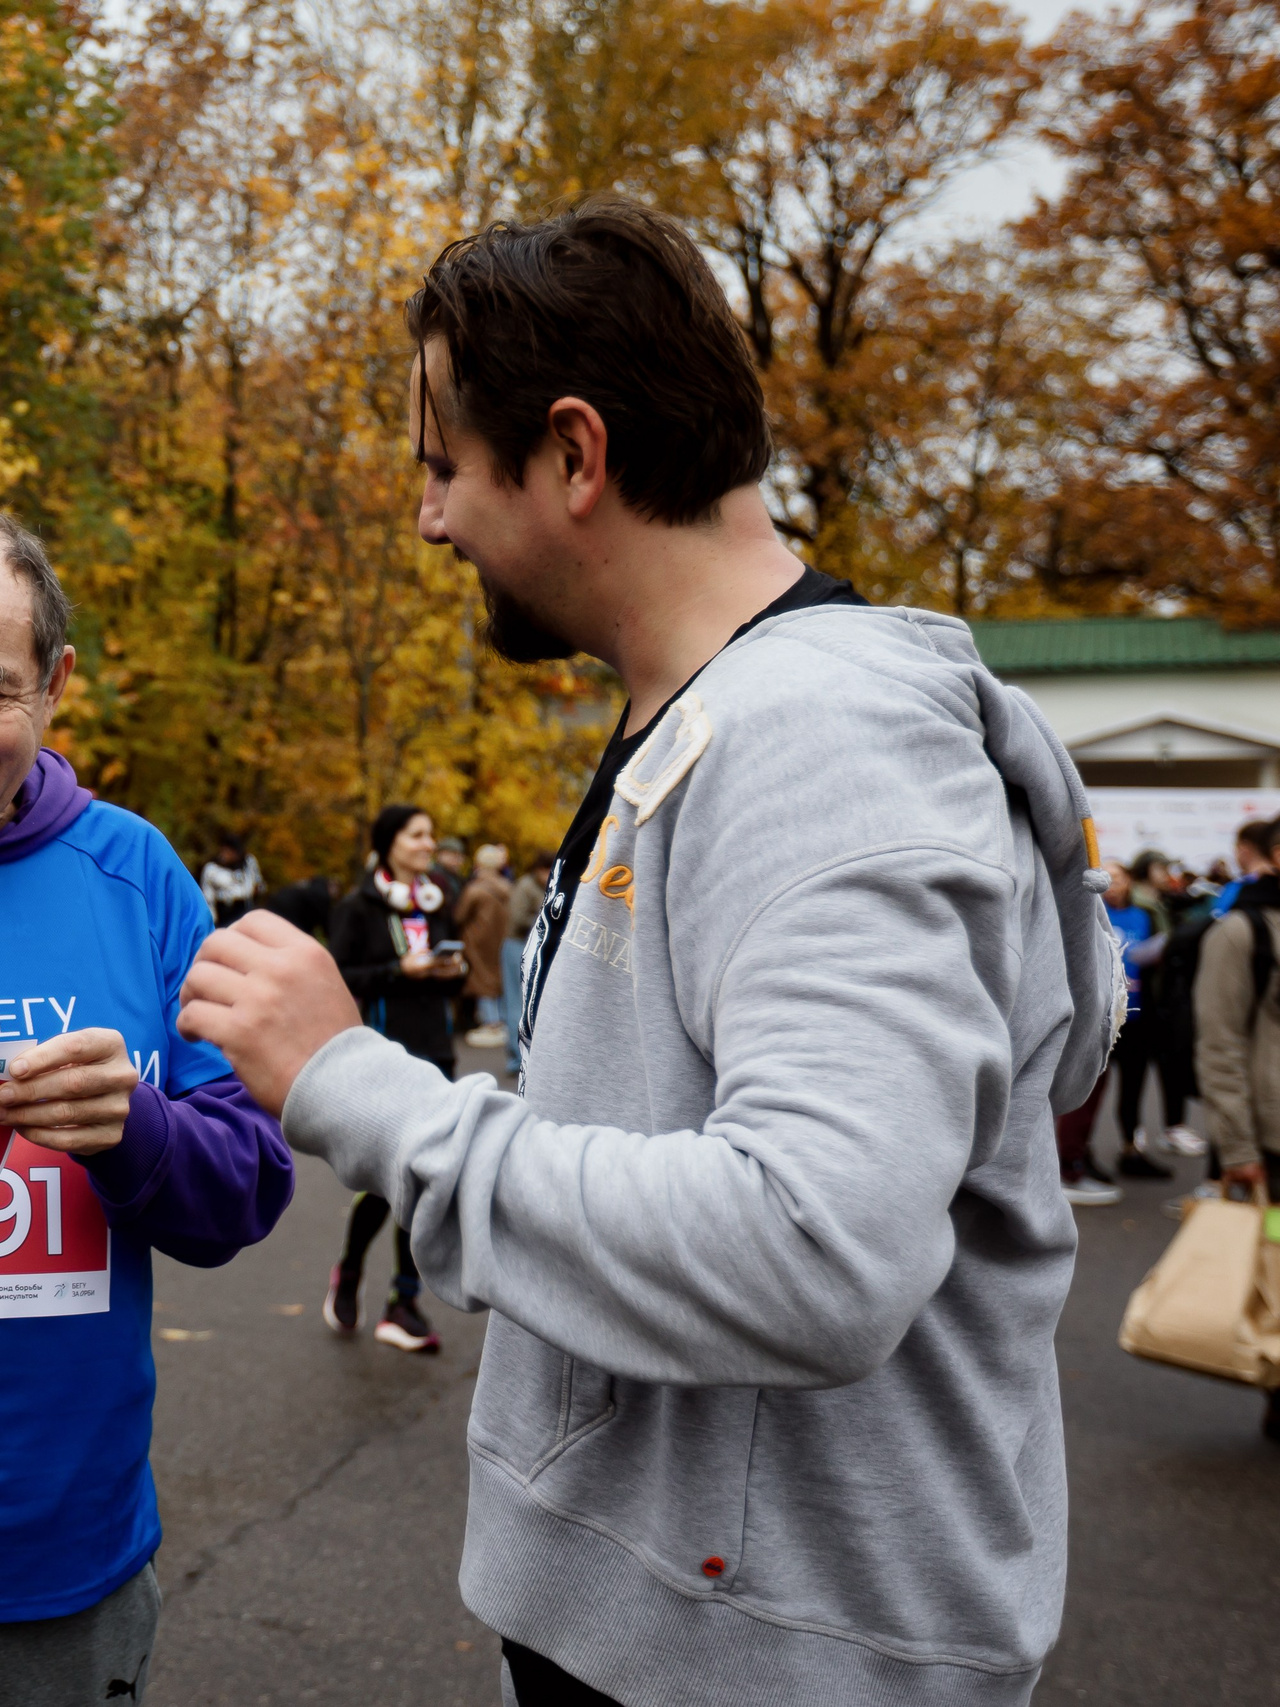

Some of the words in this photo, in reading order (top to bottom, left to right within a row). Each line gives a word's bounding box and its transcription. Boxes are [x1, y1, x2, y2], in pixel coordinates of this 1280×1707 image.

[14, 1283, 43, 1292] борьбы
[71, 1282, 87, 1290] БЕГУ
[0, 1292, 39, 1301] инсультом
